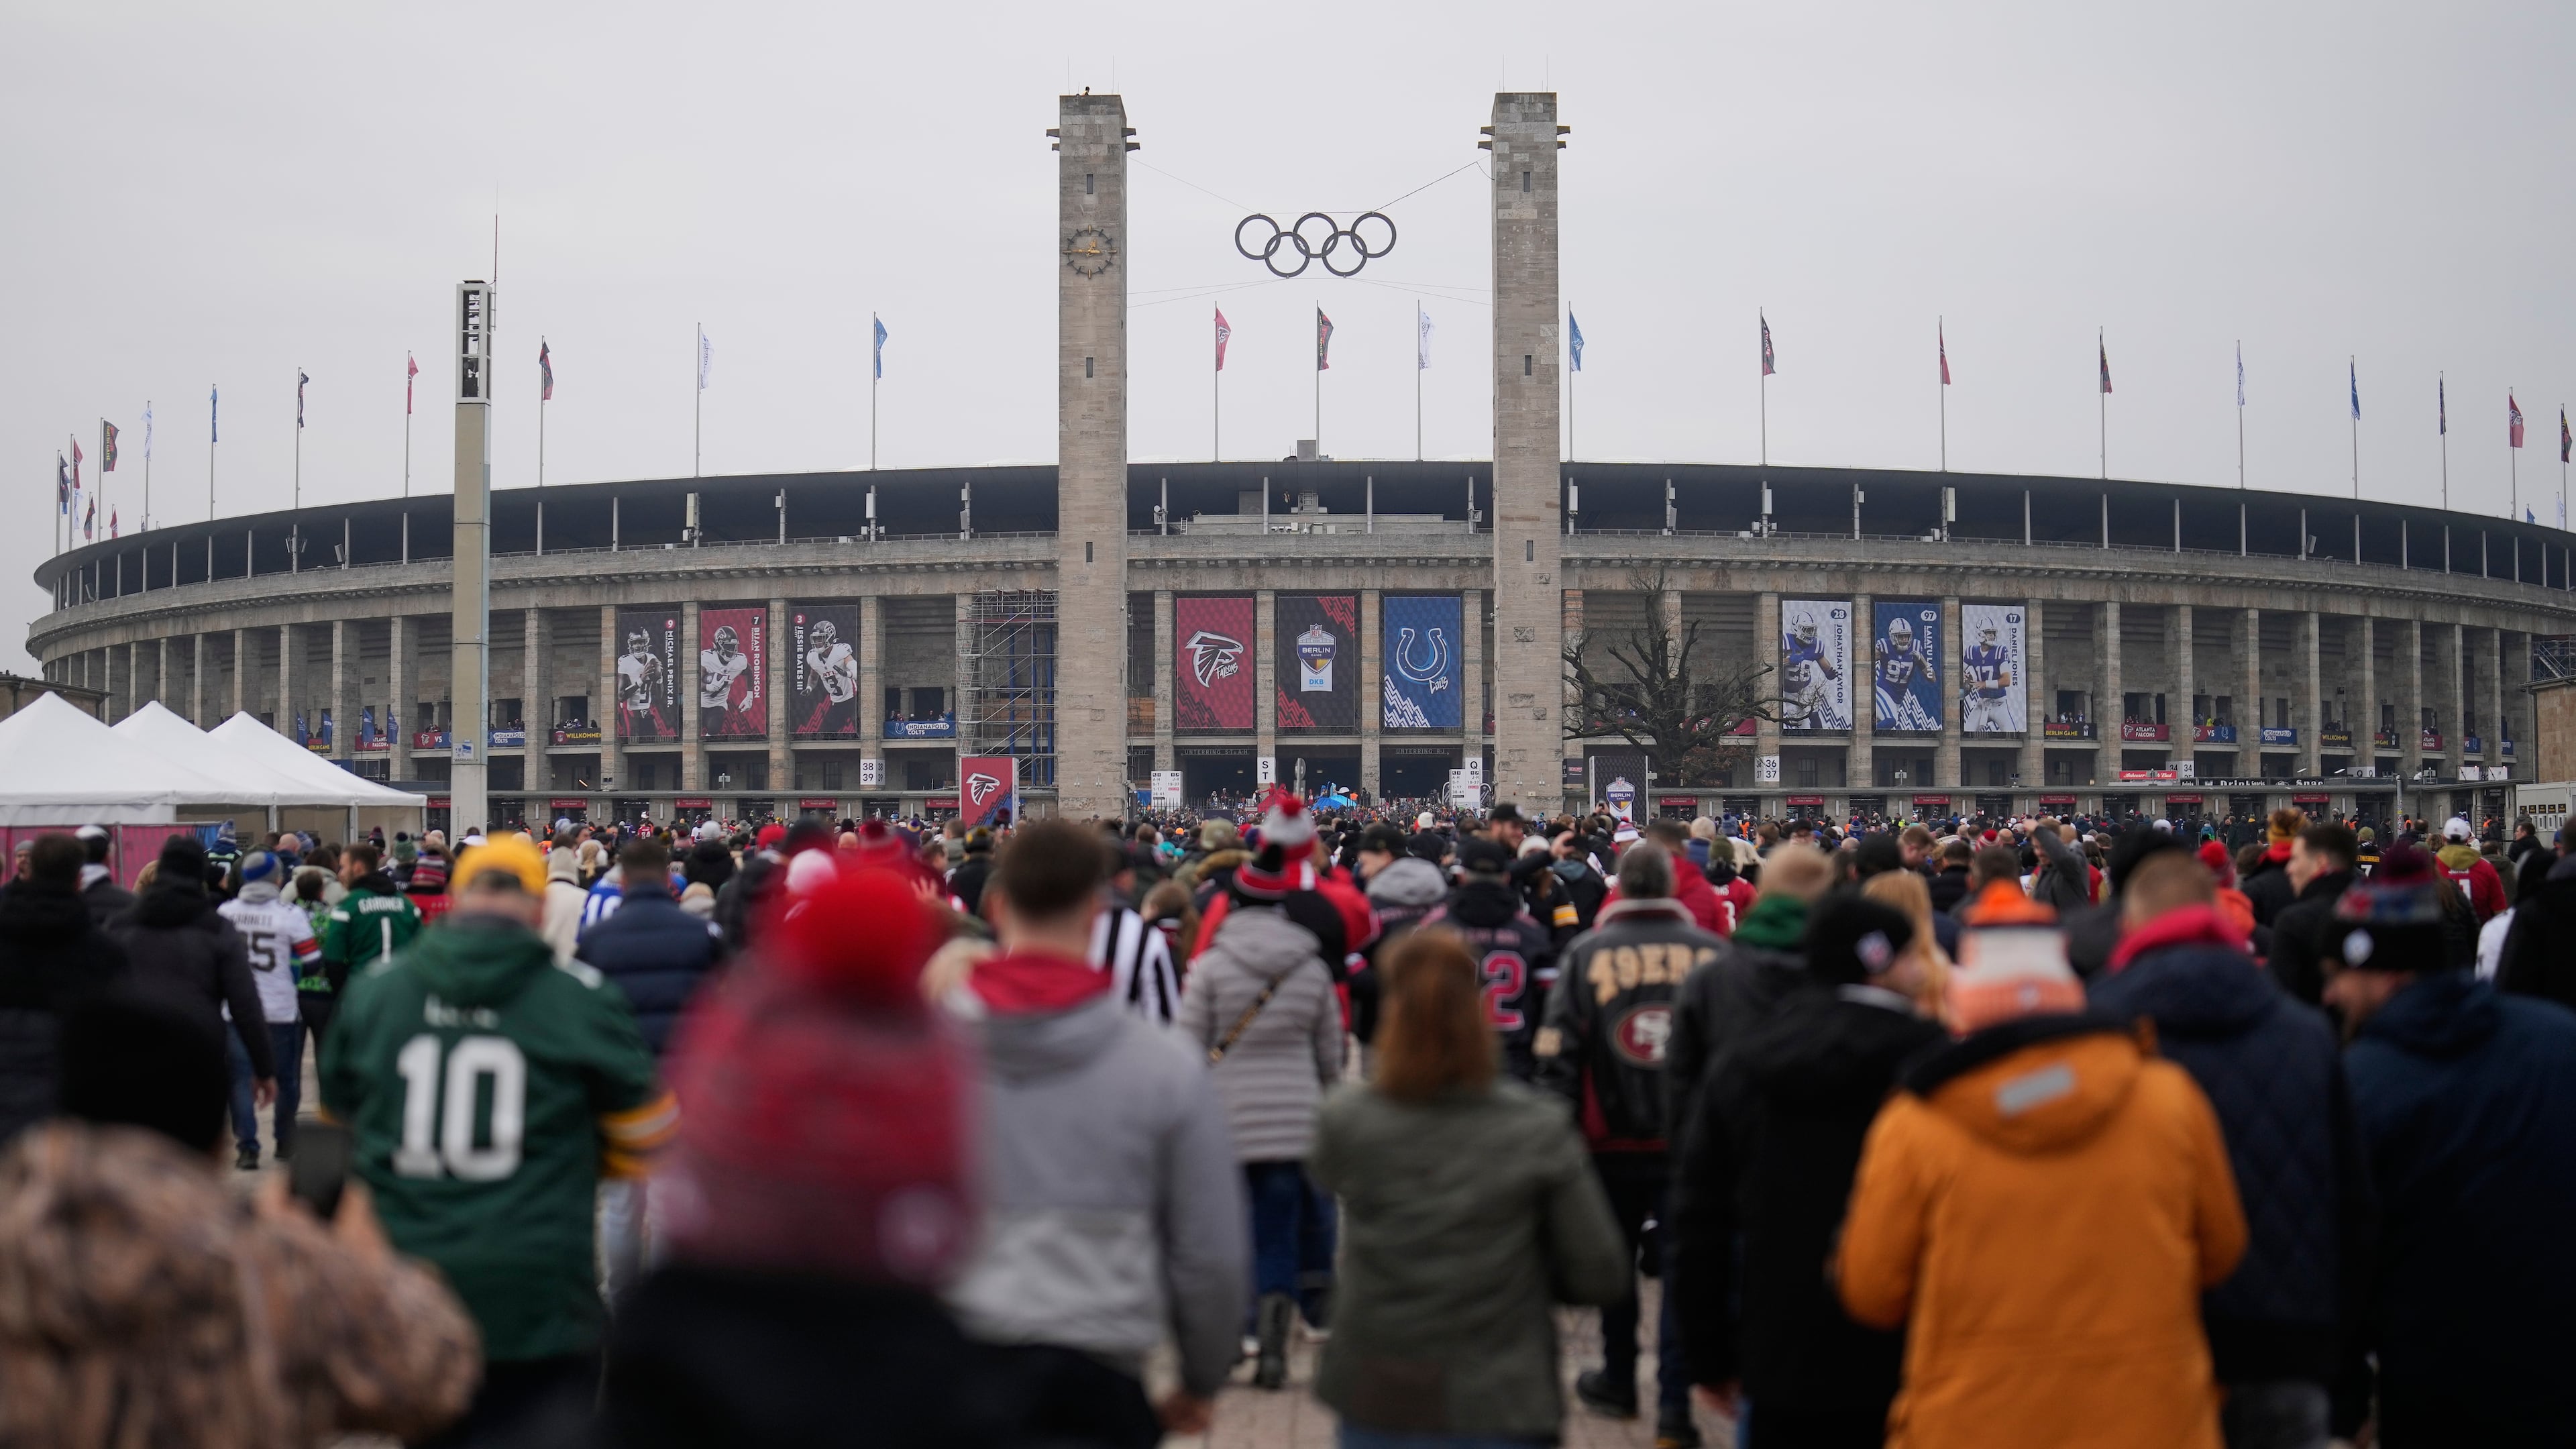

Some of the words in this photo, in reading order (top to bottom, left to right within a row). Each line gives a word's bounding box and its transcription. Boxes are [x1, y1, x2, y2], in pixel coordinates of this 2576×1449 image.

[1833, 609, 1845, 619] 28
[1924, 612, 1934, 620] 97
[2009, 614, 2018, 623] 17
[667, 619, 674, 628] 9
[753, 616, 759, 625] 7
[797, 615, 802, 623] 3
[1214, 662, 1238, 680] FALCONS
[1886, 659, 1913, 684] 97
[863, 763, 874, 771] 38
[878, 763, 883, 771] 38
[1262, 761, 1269, 769] S
[1470, 761, 1478, 769] Q
[1766, 759, 1777, 767] 36
[2184, 764, 2192, 772] 34
[863, 773, 873, 782] 39
[878, 773, 883, 782] 39
[1262, 771, 1269, 780] T
[1766, 770, 1777, 778] 37
[2360, 864, 2373, 877] 7
[358, 897, 405, 914] GARDNER
[380, 916, 392, 964] 1
[391, 1032, 527, 1182] 10
